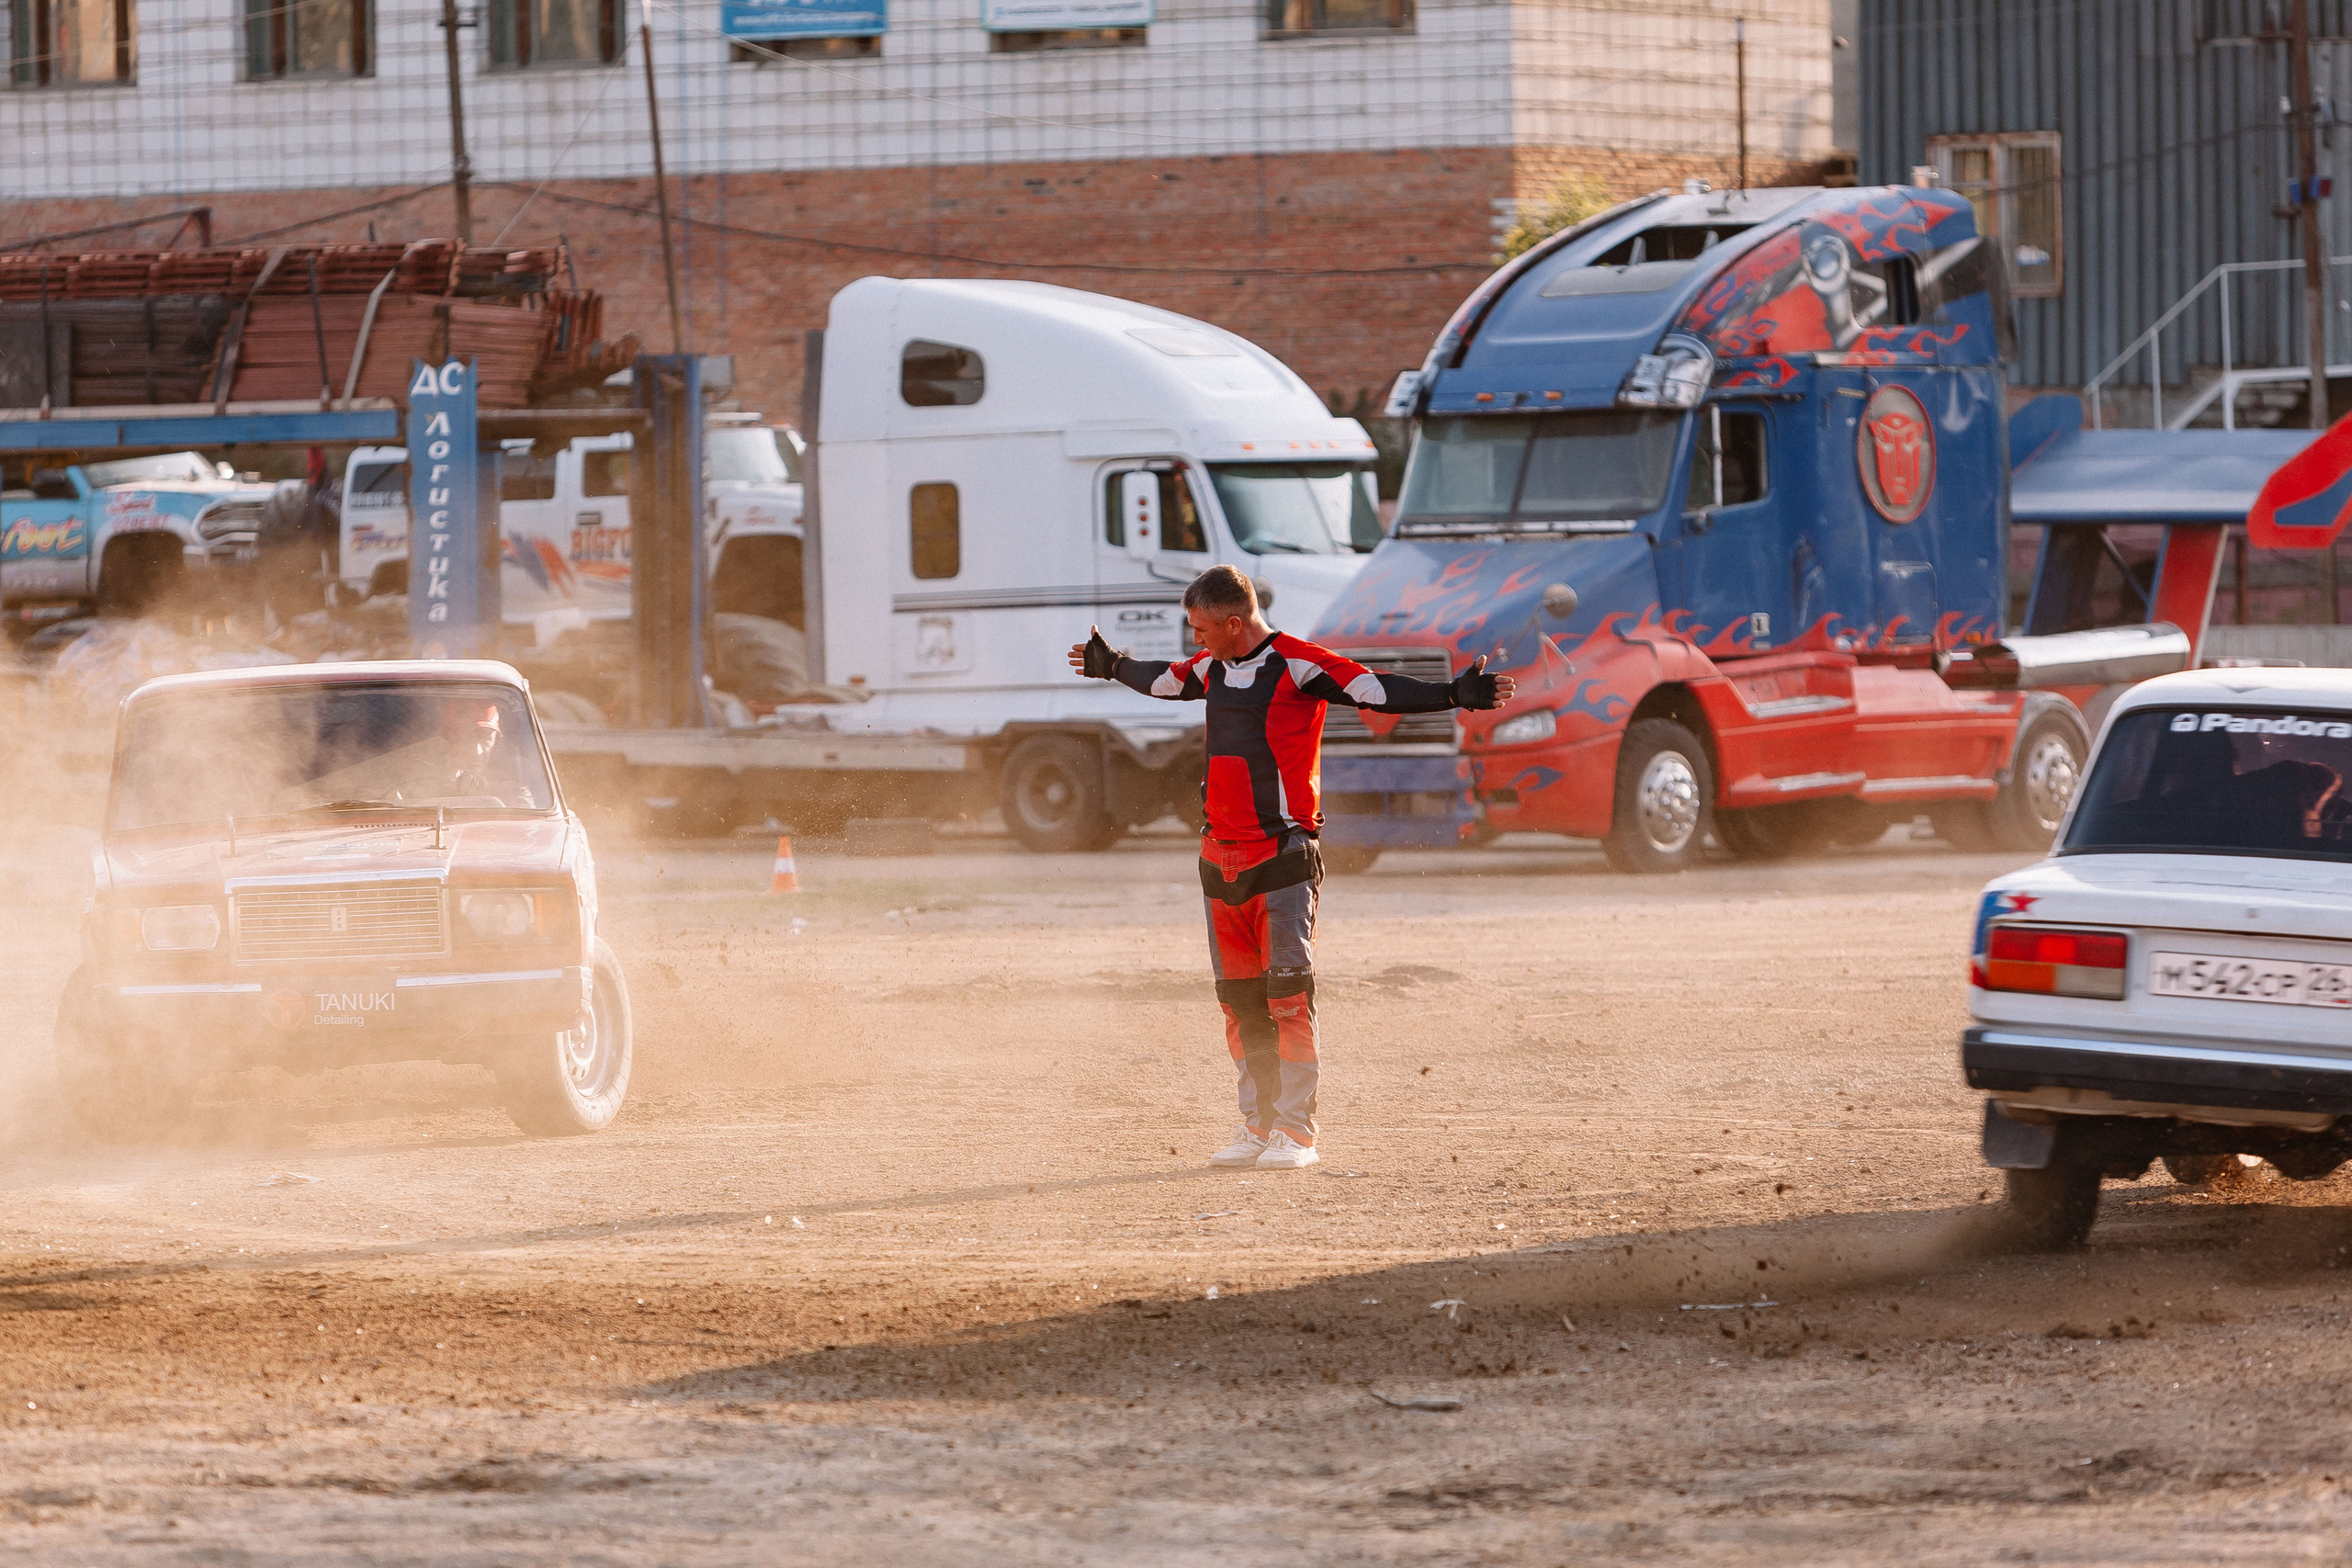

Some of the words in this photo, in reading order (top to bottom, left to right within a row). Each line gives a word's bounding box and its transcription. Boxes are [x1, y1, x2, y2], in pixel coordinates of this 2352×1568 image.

[2200, 713, 2352, 739] Pandora
[315, 992, 395, 1010] TANUKI
[313, 1014, 364, 1027] Detailing
